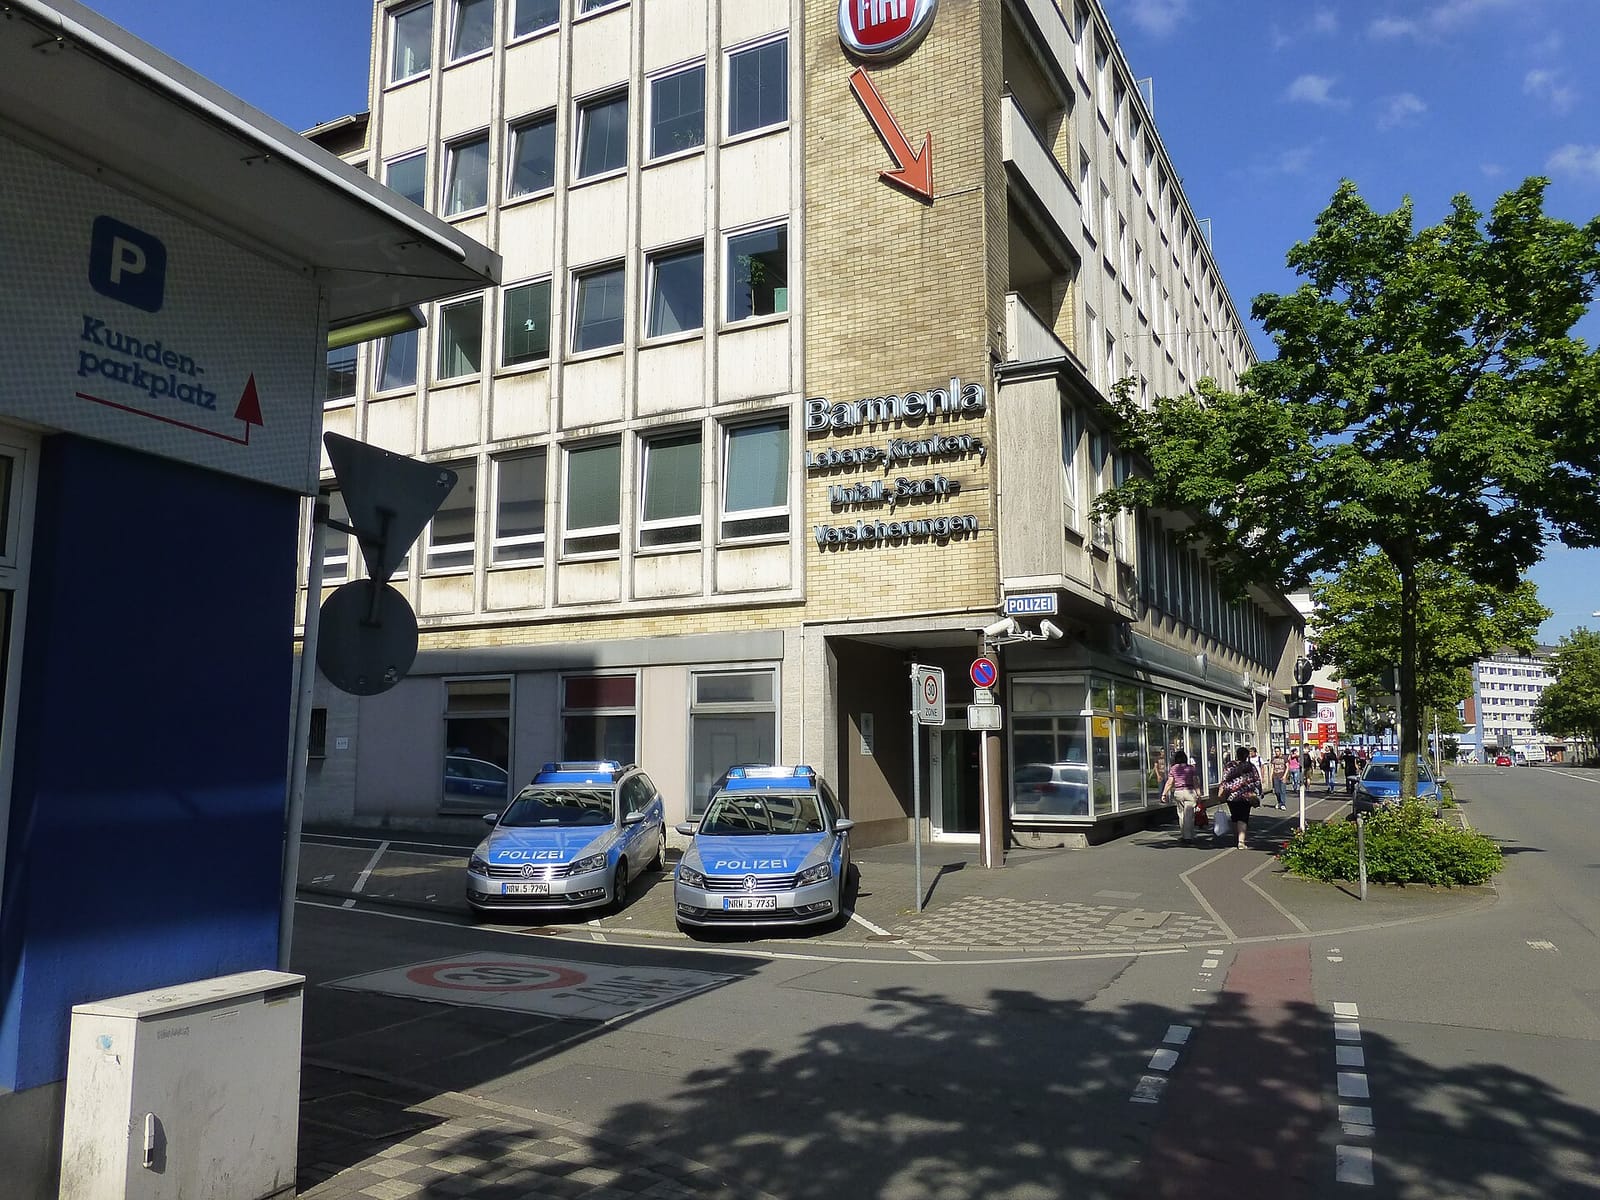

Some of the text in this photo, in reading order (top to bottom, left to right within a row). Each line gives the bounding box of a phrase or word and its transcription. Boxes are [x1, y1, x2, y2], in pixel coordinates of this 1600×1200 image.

[109, 236, 147, 284] P
[81, 314, 205, 377] Kunden-
[77, 350, 217, 412] parkplatz
[805, 376, 986, 432] Barmenia
[813, 513, 979, 545] Versicherungen
[1009, 597, 1052, 612] POLIZEI
[926, 682, 936, 697] 30
[925, 707, 938, 717] ZONE
[498, 849, 565, 860] POLIZEI
[714, 859, 789, 870] POLIZEI
[728, 899, 744, 909] NRW
[444, 967, 550, 985] 30
